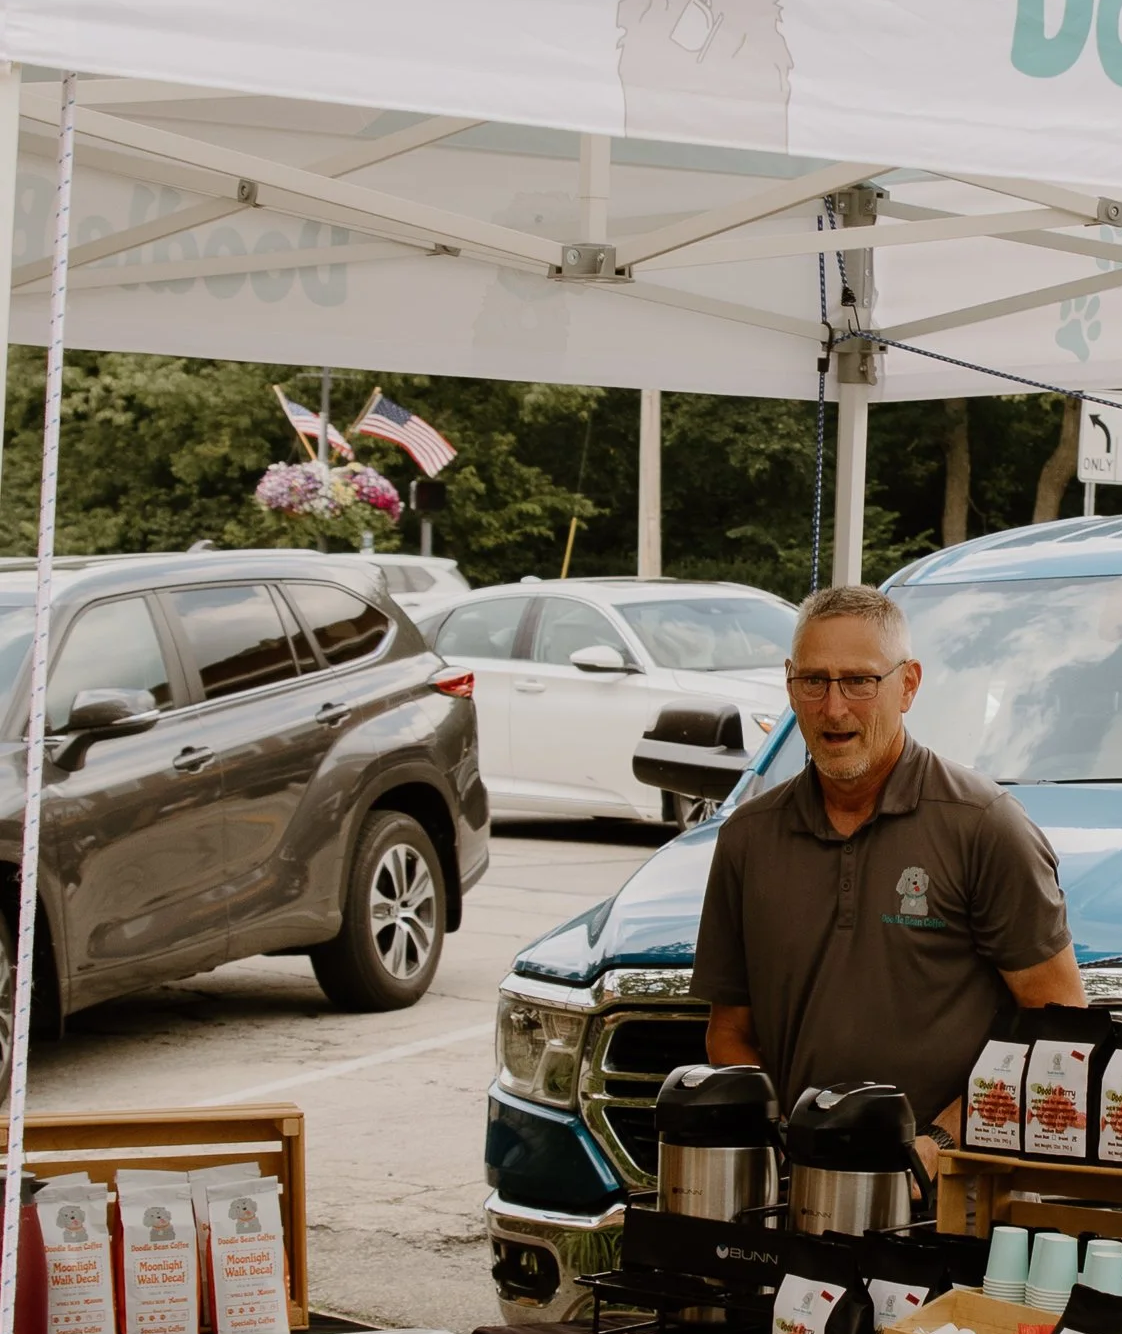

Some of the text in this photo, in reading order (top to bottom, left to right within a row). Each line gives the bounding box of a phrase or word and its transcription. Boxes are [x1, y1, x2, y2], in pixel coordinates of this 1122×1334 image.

[1083, 457, 1114, 472] ONLY
[979, 1079, 1017, 1095] Doodle Berry
[1036, 1085, 1076, 1100] Doodle Berry
[227, 1252, 270, 1266] Moonlight
[729, 1247, 778, 1266] BUNN
[54, 1260, 97, 1274] Moonlight
[139, 1260, 183, 1274] Moonlight
[225, 1263, 273, 1277] Walk Decaf
[51, 1271, 100, 1286] Walk Decaf
[137, 1271, 185, 1285] Walk Decaf
